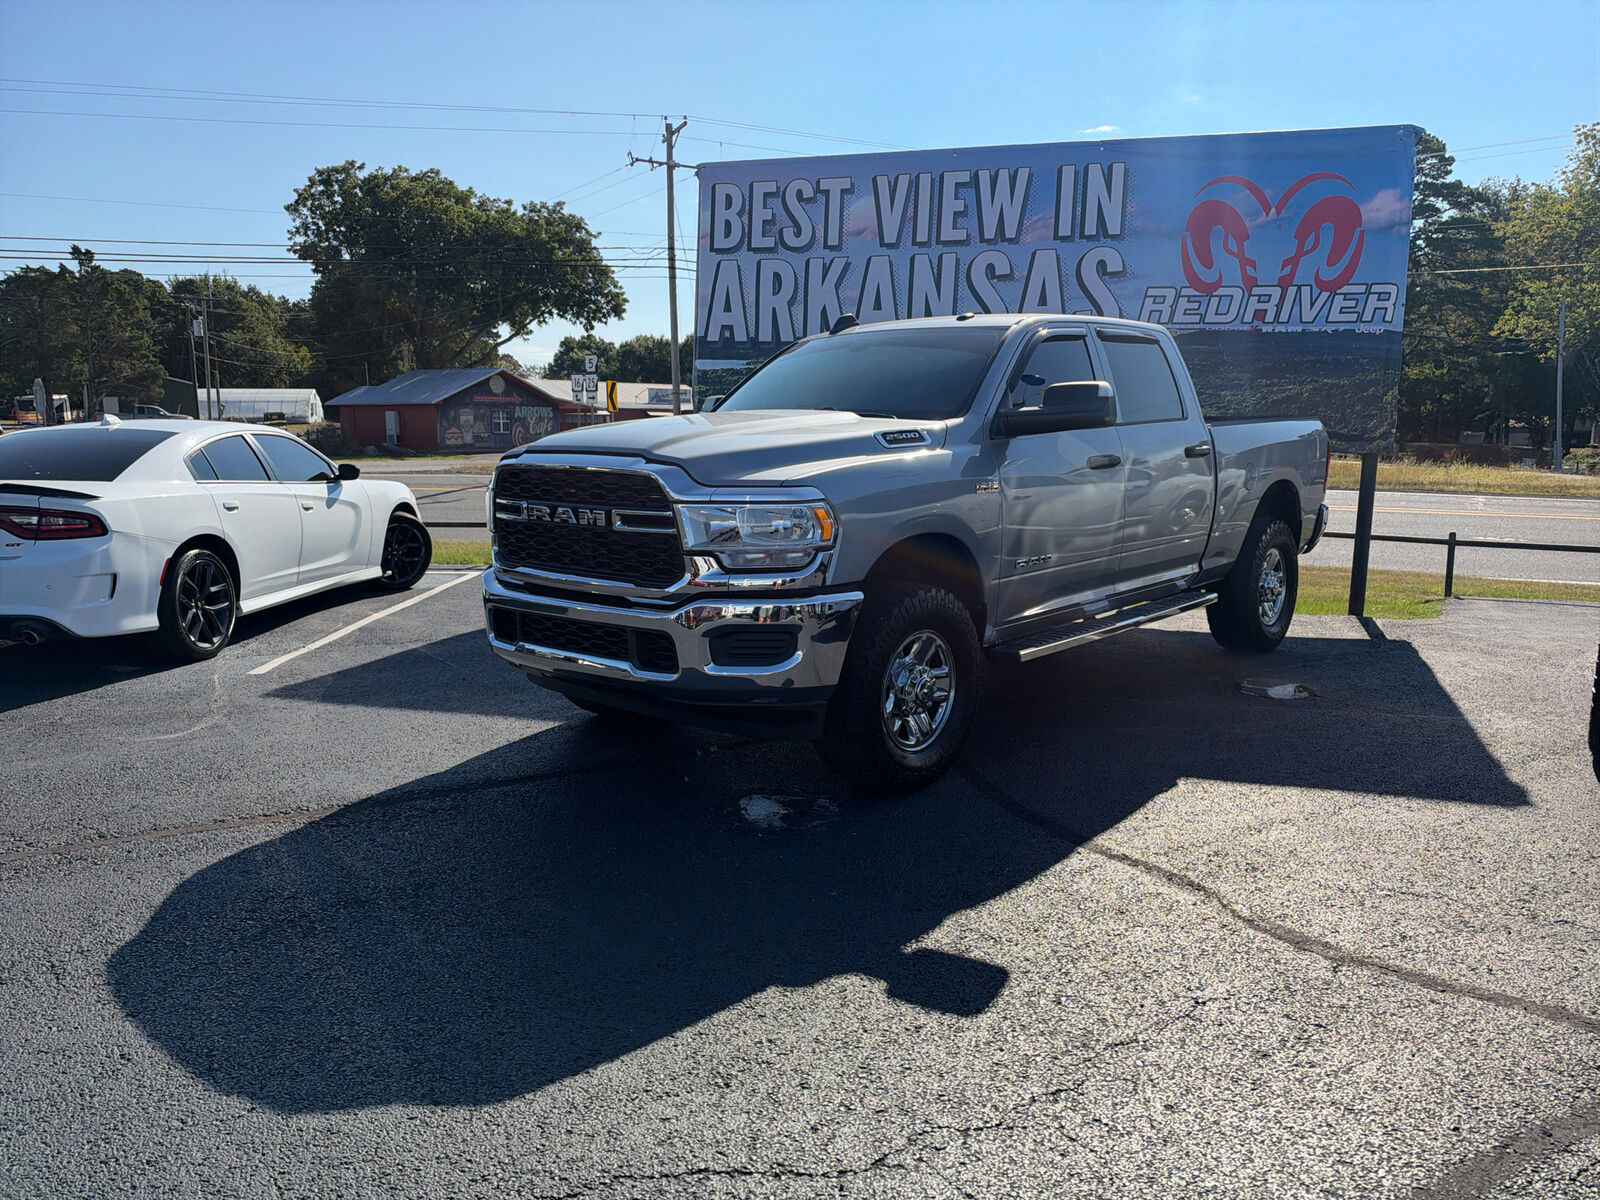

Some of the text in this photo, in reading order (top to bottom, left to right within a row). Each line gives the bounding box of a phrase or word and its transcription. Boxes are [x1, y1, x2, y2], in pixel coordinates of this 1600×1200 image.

[710, 162, 1126, 253] BEST VIEW IN
[703, 245, 1124, 343] ARKANSAS
[1138, 283, 1399, 325] REDRIVER
[1355, 323, 1384, 335] Jeep
[588, 358, 594, 369] 5
[574, 378, 580, 388] 16
[587, 377, 596, 388] 25
[514, 406, 554, 418] ARROWS
[885, 432, 919, 440] 2500
[528, 504, 606, 526] RAM
